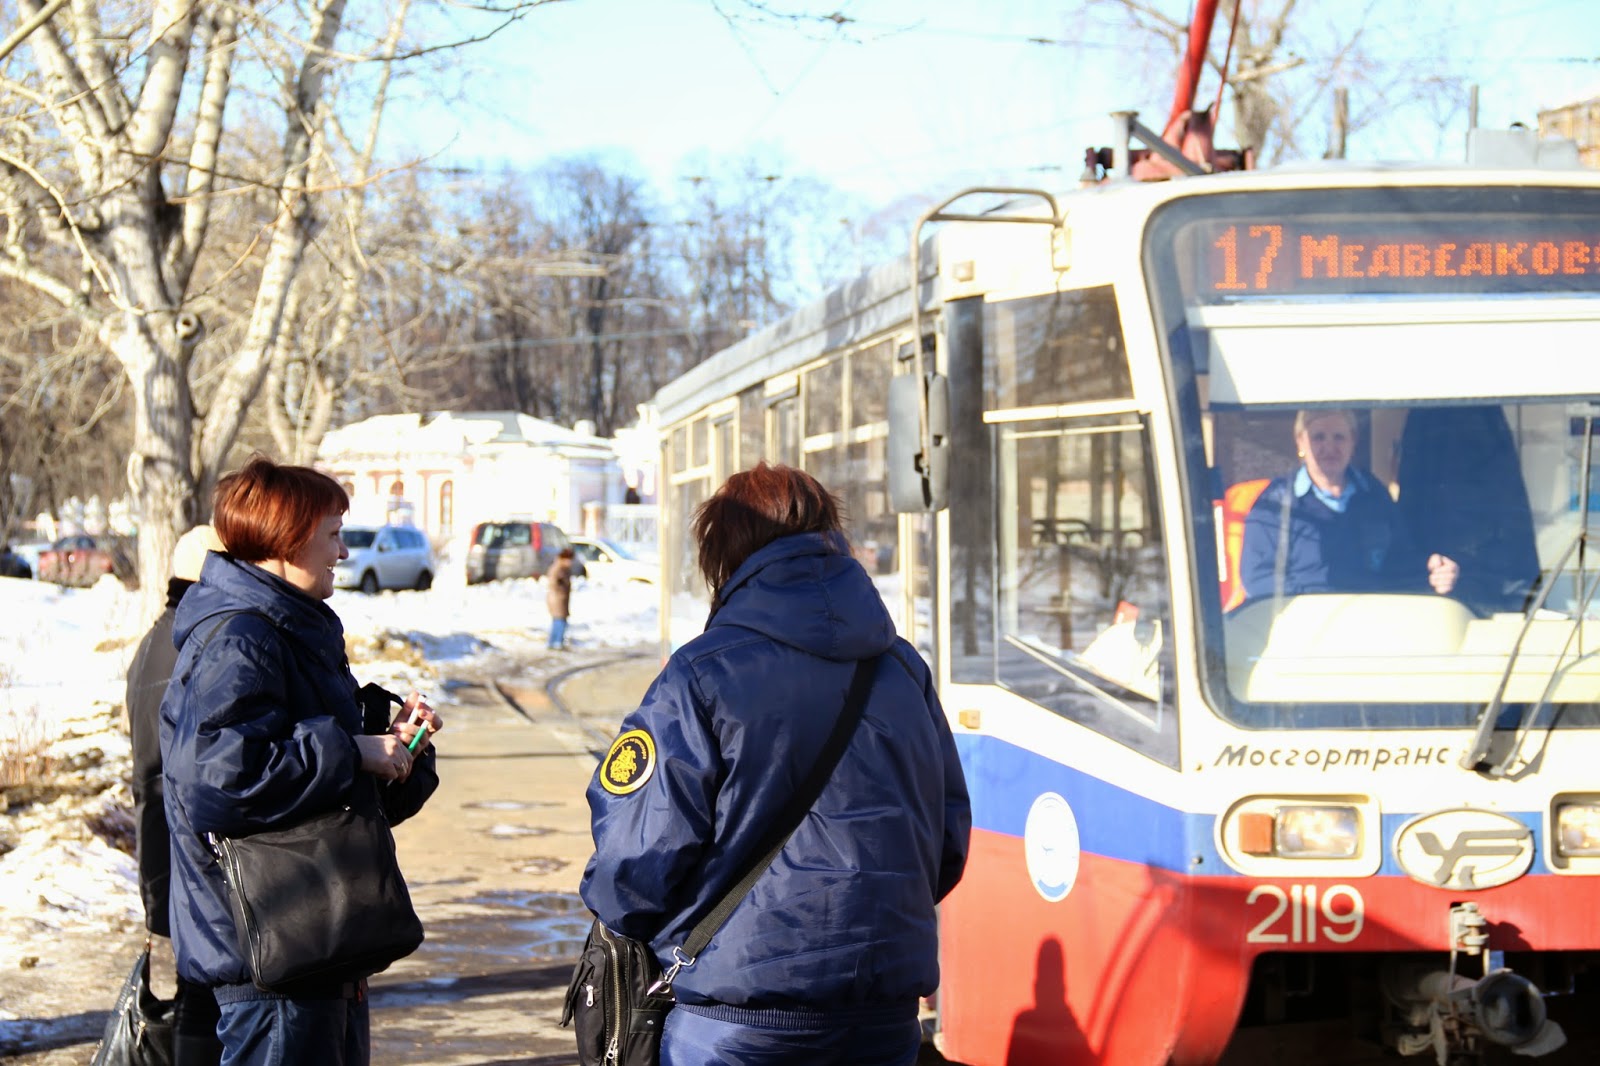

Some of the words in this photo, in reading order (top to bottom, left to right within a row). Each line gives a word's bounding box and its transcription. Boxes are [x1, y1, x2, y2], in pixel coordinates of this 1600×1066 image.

[1214, 225, 1283, 289] 17
[1300, 235, 1600, 278] МЕДВЕДКОВ
[1214, 744, 1450, 772] Мосгортранс
[1246, 884, 1365, 944] 2119
